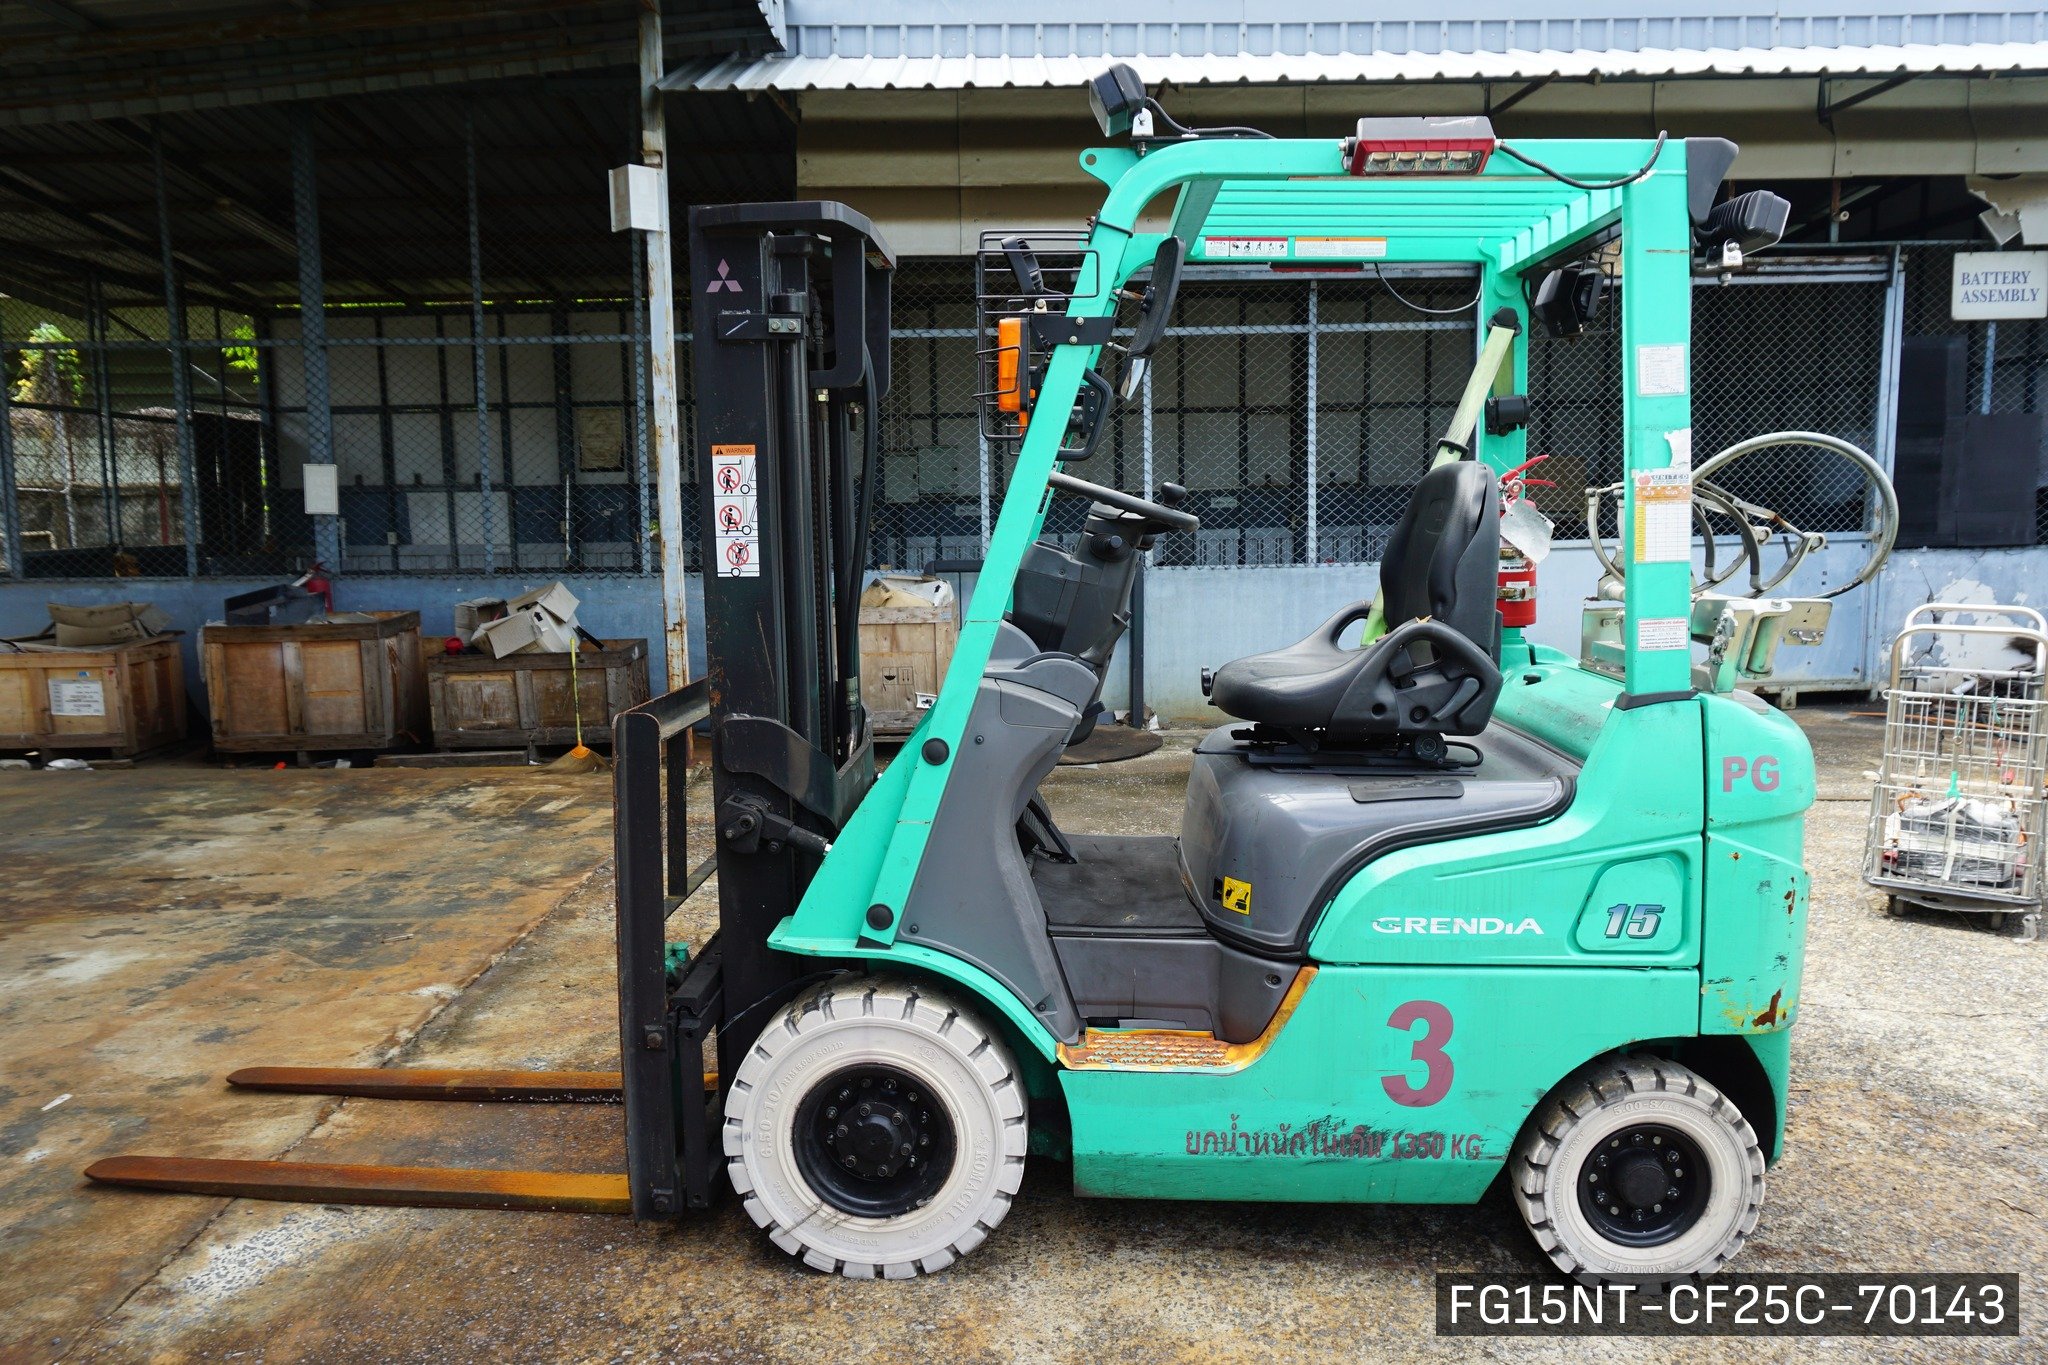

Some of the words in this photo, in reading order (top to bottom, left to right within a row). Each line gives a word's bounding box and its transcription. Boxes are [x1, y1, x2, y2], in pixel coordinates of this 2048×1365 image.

[1961, 271, 2031, 286] BATTERY
[1961, 288, 2040, 303] ASSEMBLY
[1723, 754, 1780, 793] PG
[1372, 916, 1544, 935] GRENDIA
[1604, 903, 1666, 939] 15
[1380, 1000, 1454, 1107] 3
[1391, 1132, 1444, 1160] 1350
[1451, 1133, 1484, 1161] KG
[948, 1151, 991, 1221] KOMACHI
